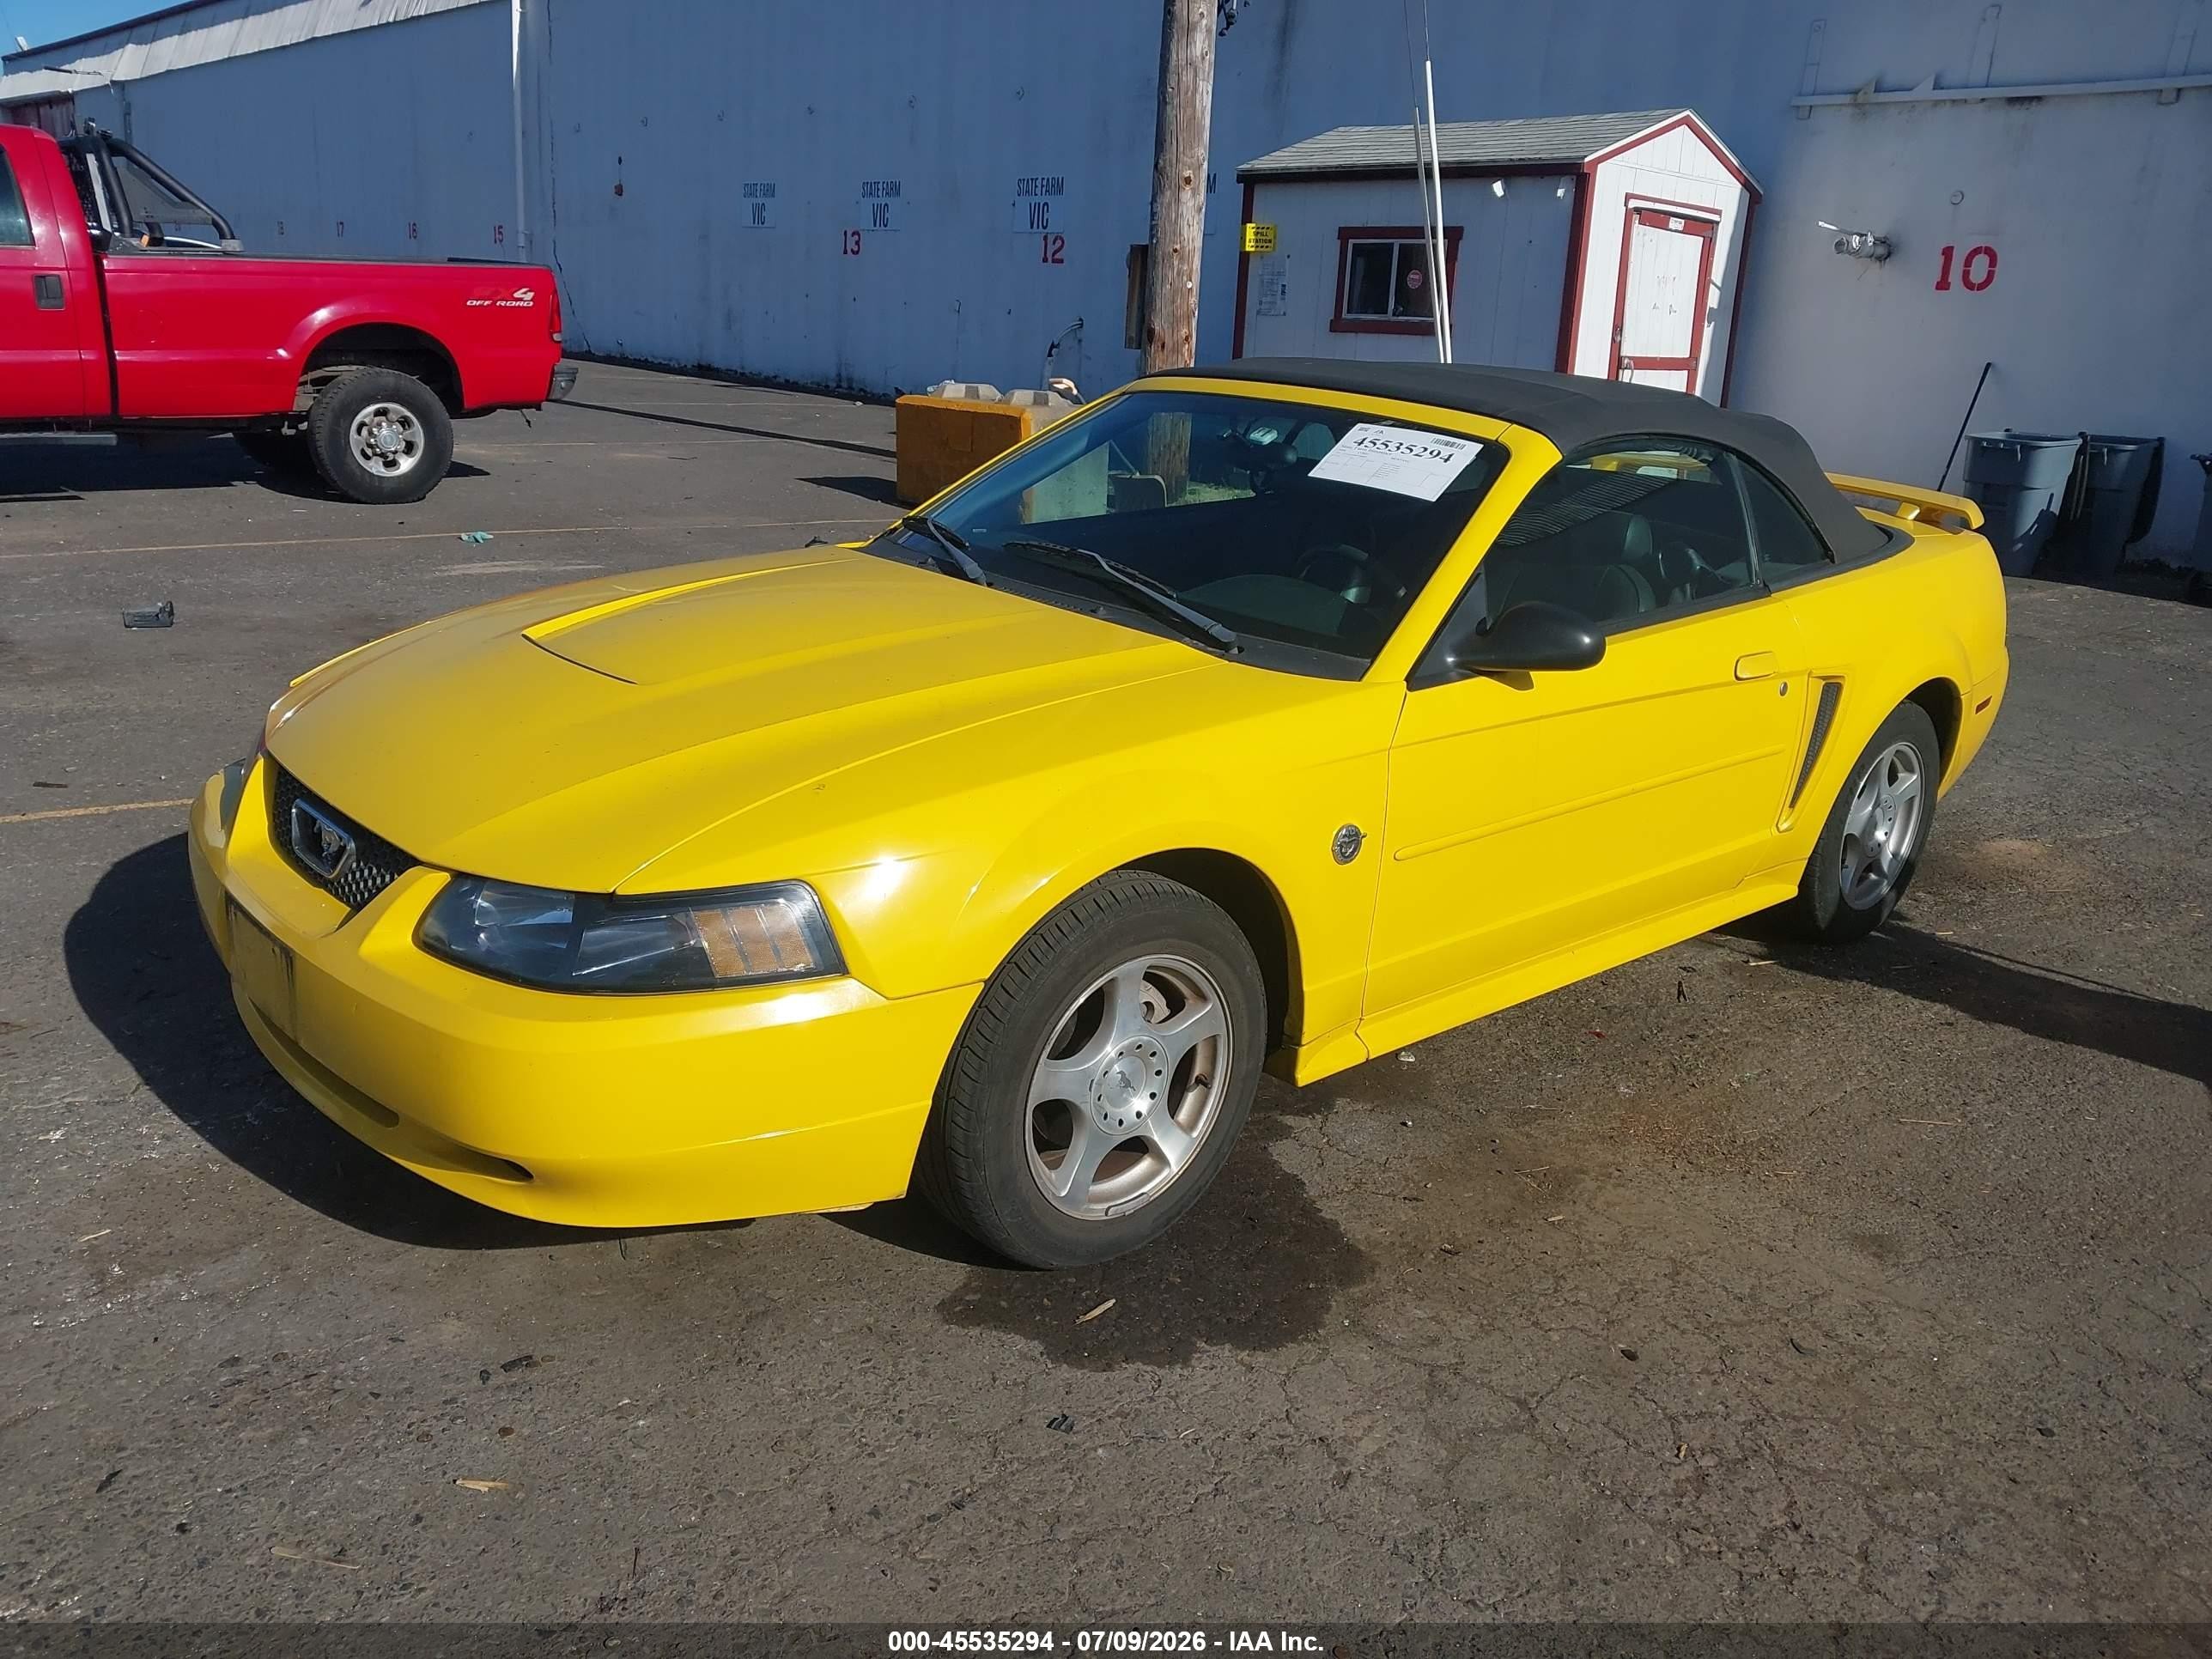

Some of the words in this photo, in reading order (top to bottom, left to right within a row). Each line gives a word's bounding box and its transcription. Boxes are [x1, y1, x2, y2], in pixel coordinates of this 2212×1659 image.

[743, 183, 759, 198] STATE
[759, 182, 776, 198] FARM
[861, 181, 881, 199] STATE
[882, 180, 901, 198] FARM
[1017, 178, 1039, 197] STATE
[1040, 176, 1065, 197] FARM
[751, 203, 766, 226] VIC
[872, 203, 890, 228] VIC
[1029, 202, 1049, 230] VIC
[336, 222, 344, 238] 17
[494, 225, 504, 245] 15
[842, 230, 861, 256] 13
[1042, 234, 1066, 264] 12
[1935, 246, 1998, 292] 10
[1352, 436, 1455, 464] 45535294
